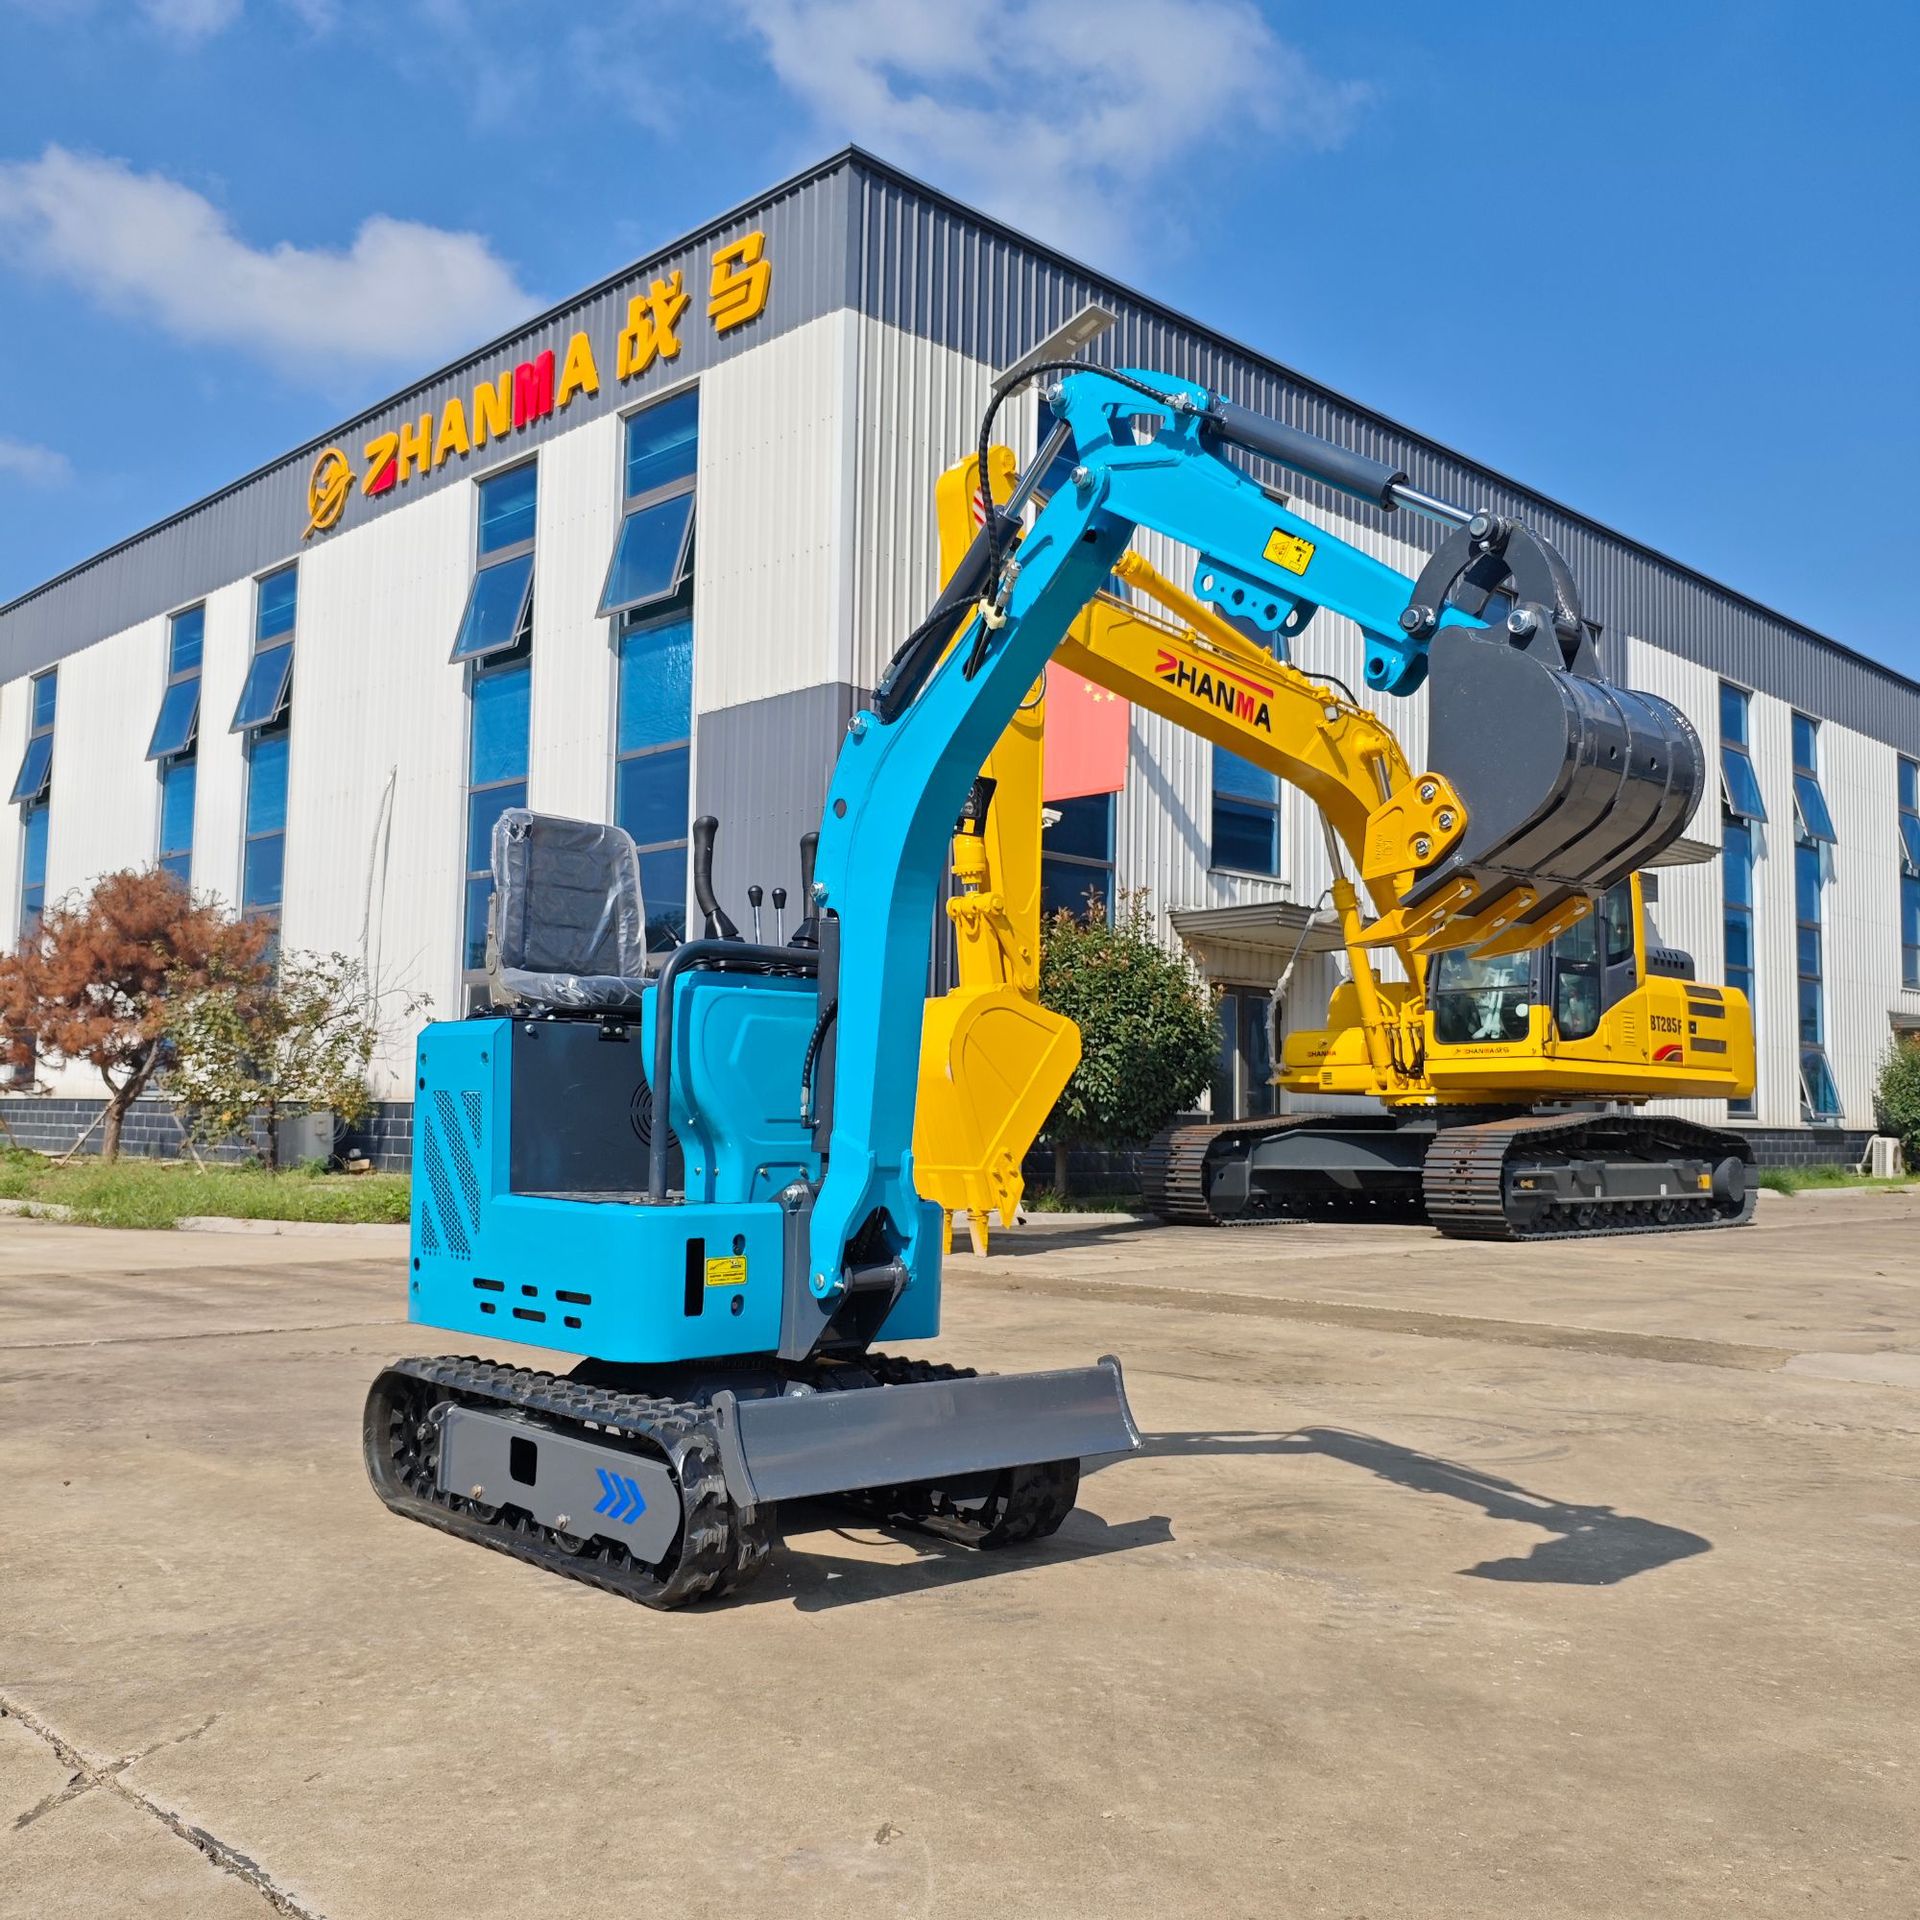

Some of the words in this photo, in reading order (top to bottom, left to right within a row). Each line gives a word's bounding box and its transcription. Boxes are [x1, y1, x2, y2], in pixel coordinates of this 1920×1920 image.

[361, 331, 600, 496] ZHANMA
[616, 230, 771, 381] 战马
[1155, 649, 1271, 733] ZHANMA
